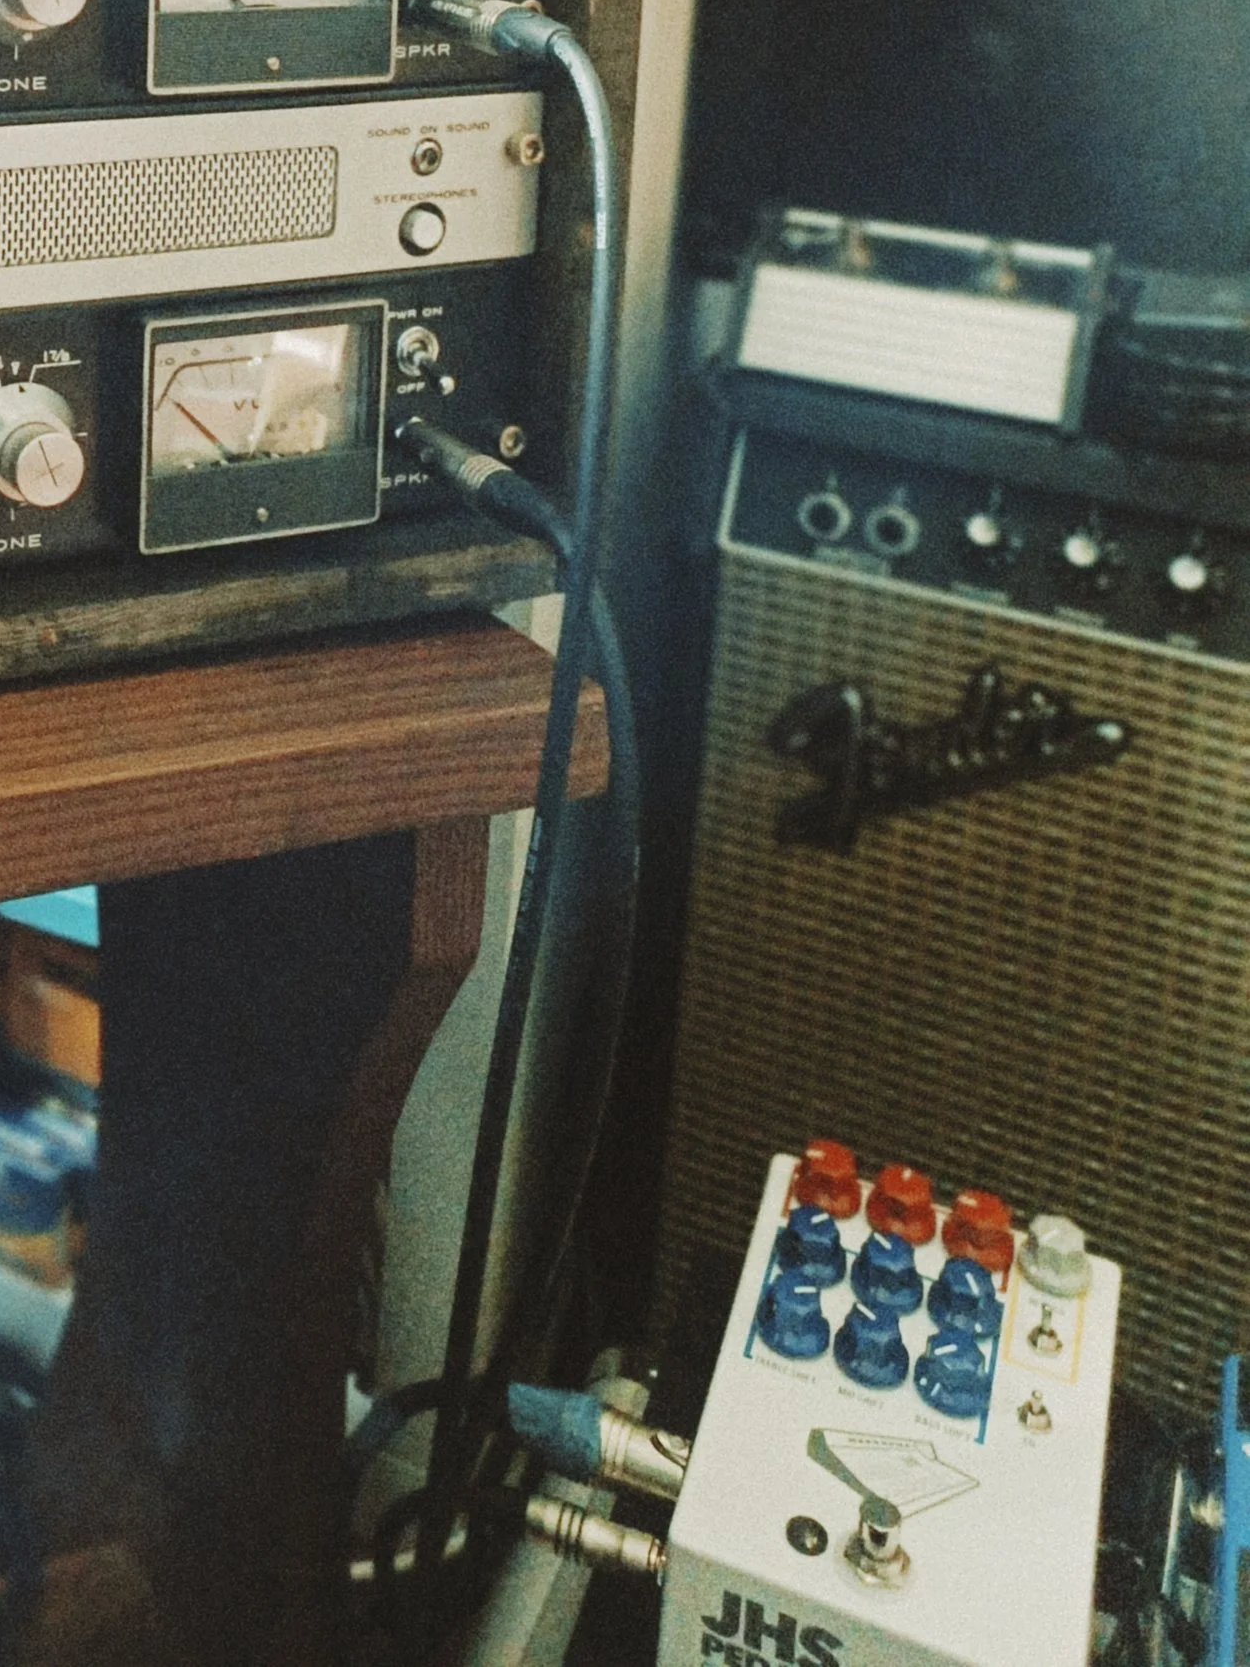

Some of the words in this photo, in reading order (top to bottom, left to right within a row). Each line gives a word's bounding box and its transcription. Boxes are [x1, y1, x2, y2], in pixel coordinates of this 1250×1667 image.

[395, 42, 452, 59] SPKR
[367, 126, 411, 138] SOUND
[419, 125, 438, 135] ON
[446, 121, 490, 133] SOUND
[373, 187, 478, 204] STEREOPHONES
[387, 308, 417, 319] PWR
[421, 306, 444, 318] ON
[396, 381, 426, 395] OFF
[700, 1589, 844, 1667] JHS
